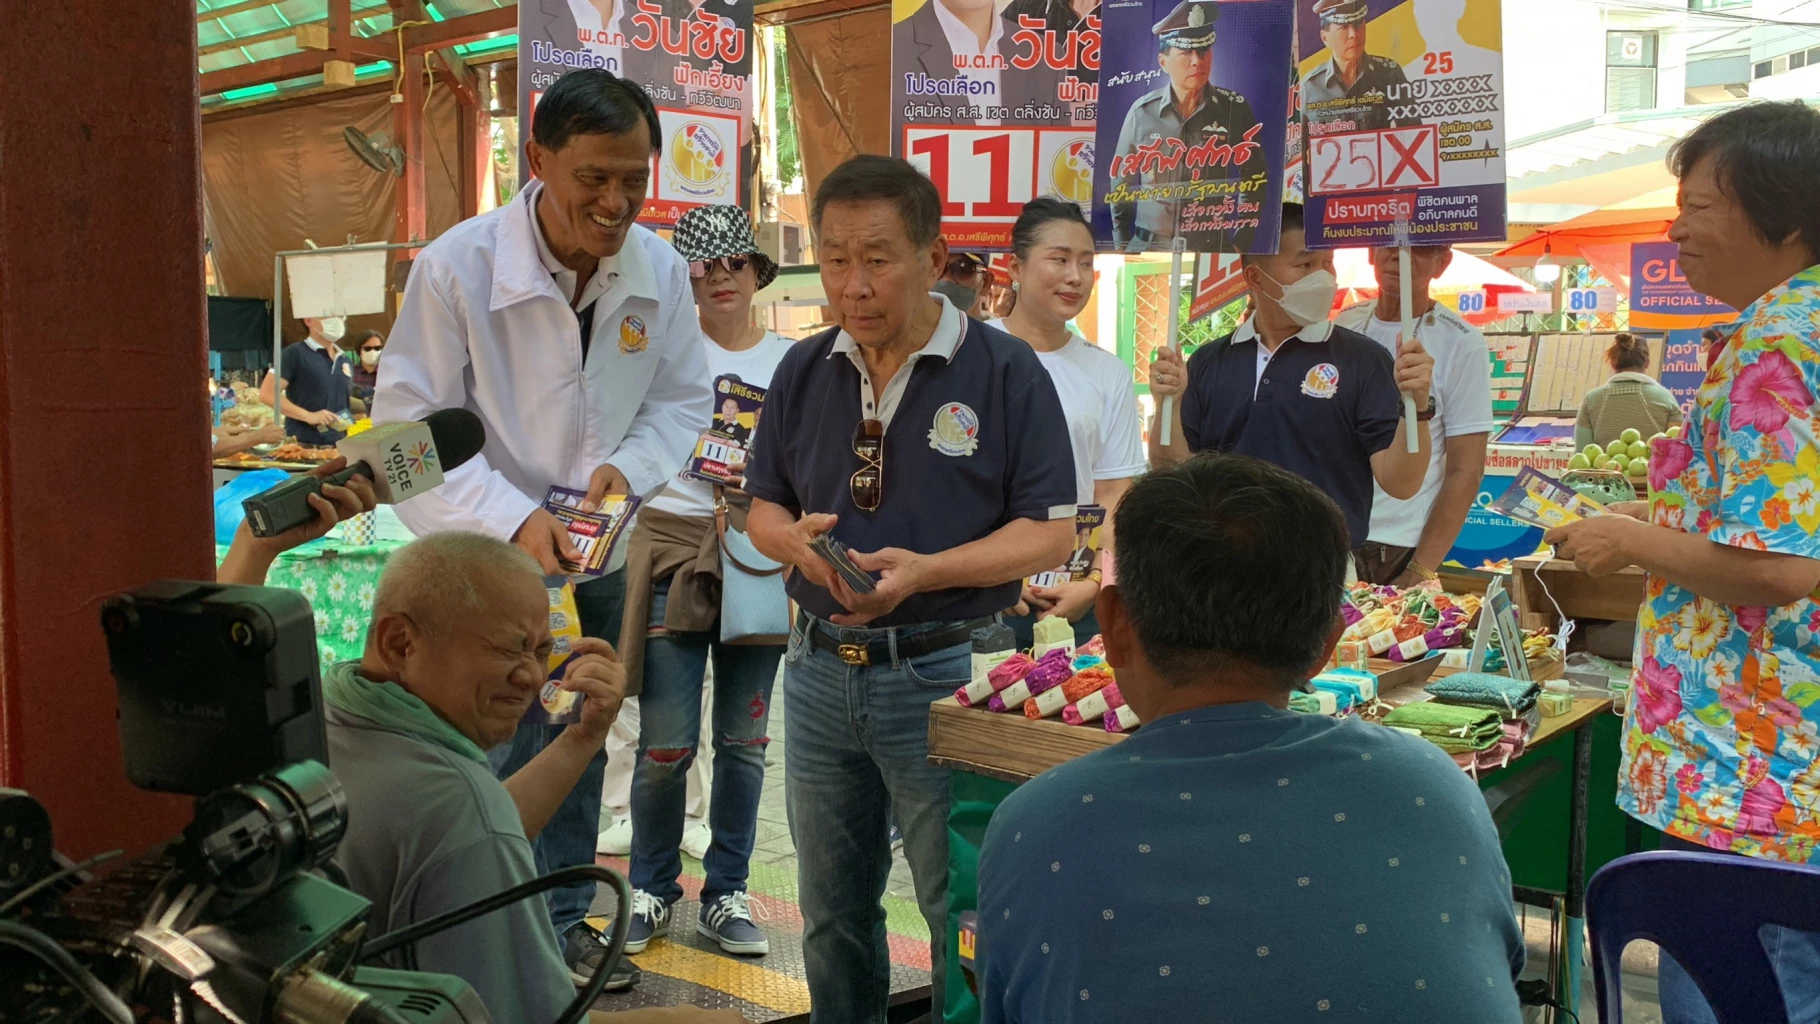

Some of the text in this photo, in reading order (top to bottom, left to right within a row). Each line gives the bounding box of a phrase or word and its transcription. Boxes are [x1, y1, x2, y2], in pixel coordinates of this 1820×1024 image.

[577, 0, 745, 63] พ.ต.ท. วันชัย
[952, 14, 1101, 70] พ.ต.ท. วันชั
[531, 40, 618, 71] โปรดเลือก
[1423, 51, 1454, 75] 25
[673, 60, 745, 92] ฟักเอี้ยง
[904, 72, 996, 96] โปรดเลือก
[640, 81, 677, 101] ลิ่งชัน
[1387, 79, 1427, 100] นาย
[903, 101, 951, 121] ผู้สมัคร
[956, 106, 983, 119] ส.ส.
[986, 106, 1009, 119] เขต
[1014, 100, 1060, 119] ตลิ่งชัน
[1075, 103, 1098, 119] ทวี
[1110, 122, 1263, 180] เสรีพิศุทธ์
[1316, 138, 1377, 189] 25
[911, 133, 1026, 217] 11
[1328, 199, 1410, 221] ปราบทุจริต
[1417, 194, 1478, 207] พิชิตคนพาล
[1418, 205, 1478, 220] อภิบาลคนดี
[1459, 293, 1483, 311] 80
[1570, 290, 1597, 310] 80
[1640, 296, 1702, 307] OFFICIAL
[706, 443, 722, 460] 11
[384, 459, 397, 484] TV 21
[390, 442, 412, 491] VOICE
[1076, 513, 1100, 523] วมไทย
[1489, 518, 1530, 528] SELLERS
[1034, 574, 1050, 585] 11
